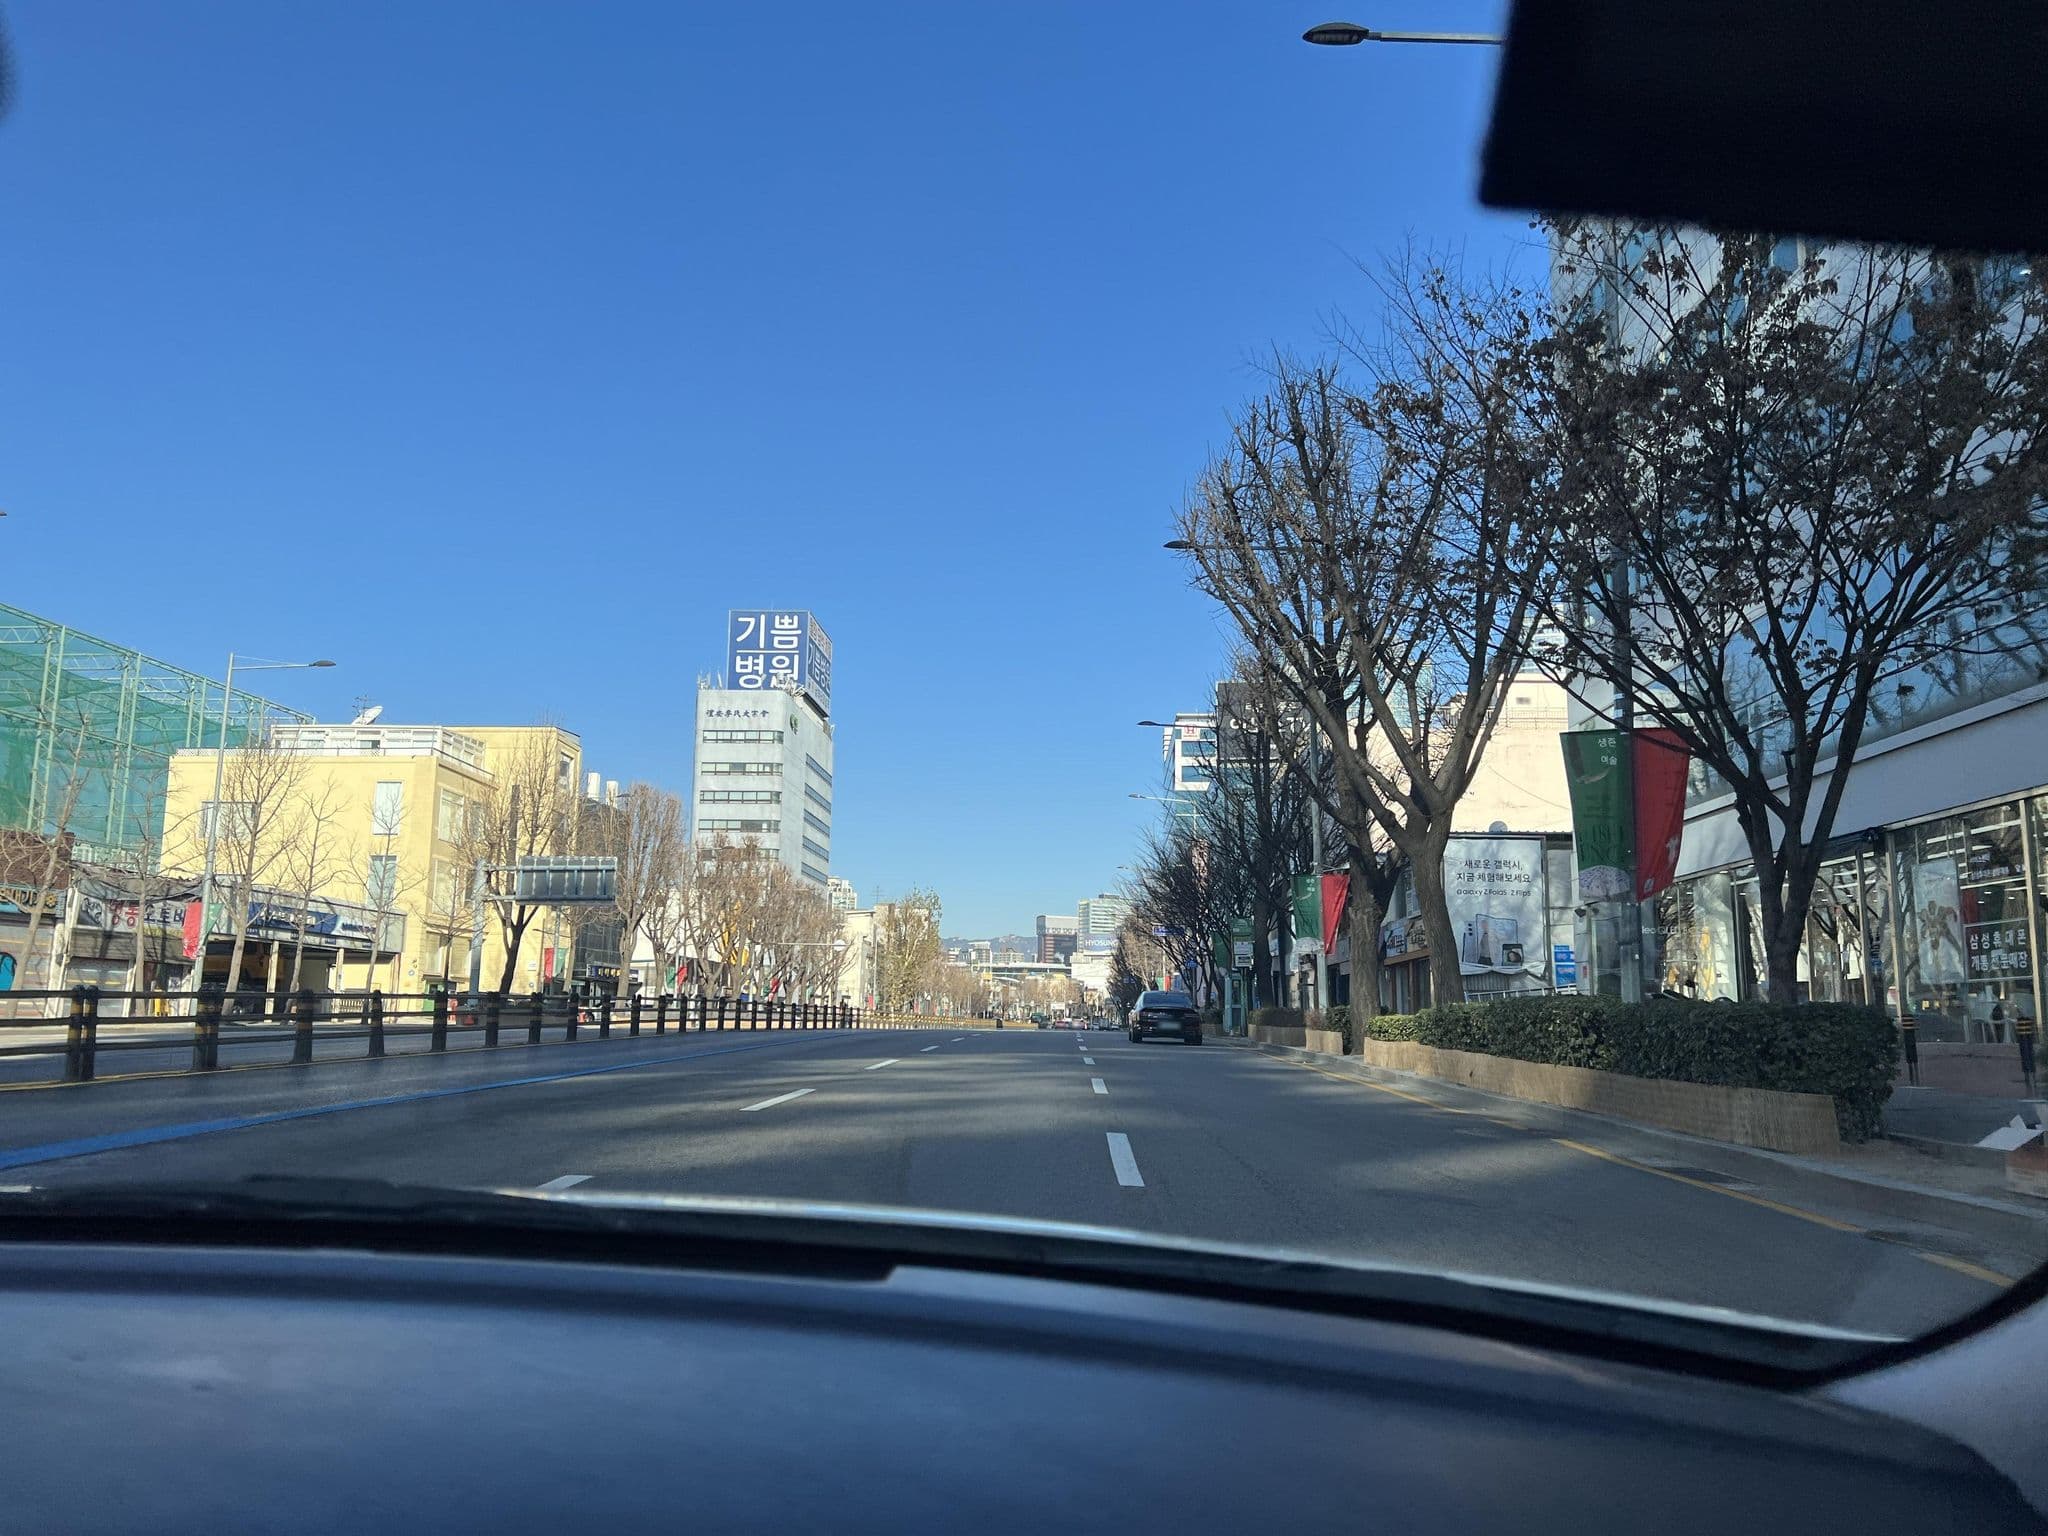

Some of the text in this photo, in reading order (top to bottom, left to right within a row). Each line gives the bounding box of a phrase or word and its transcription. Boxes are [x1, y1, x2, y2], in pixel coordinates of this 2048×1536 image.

[736, 614, 802, 649] 기쁨
[735, 654, 799, 689] 병원
[1464, 859, 1523, 871] 새로운 갤럭시,
[1456, 872, 1531, 883] 지금 체험해보세요
[1969, 928, 2027, 950] 삼성휴대폰
